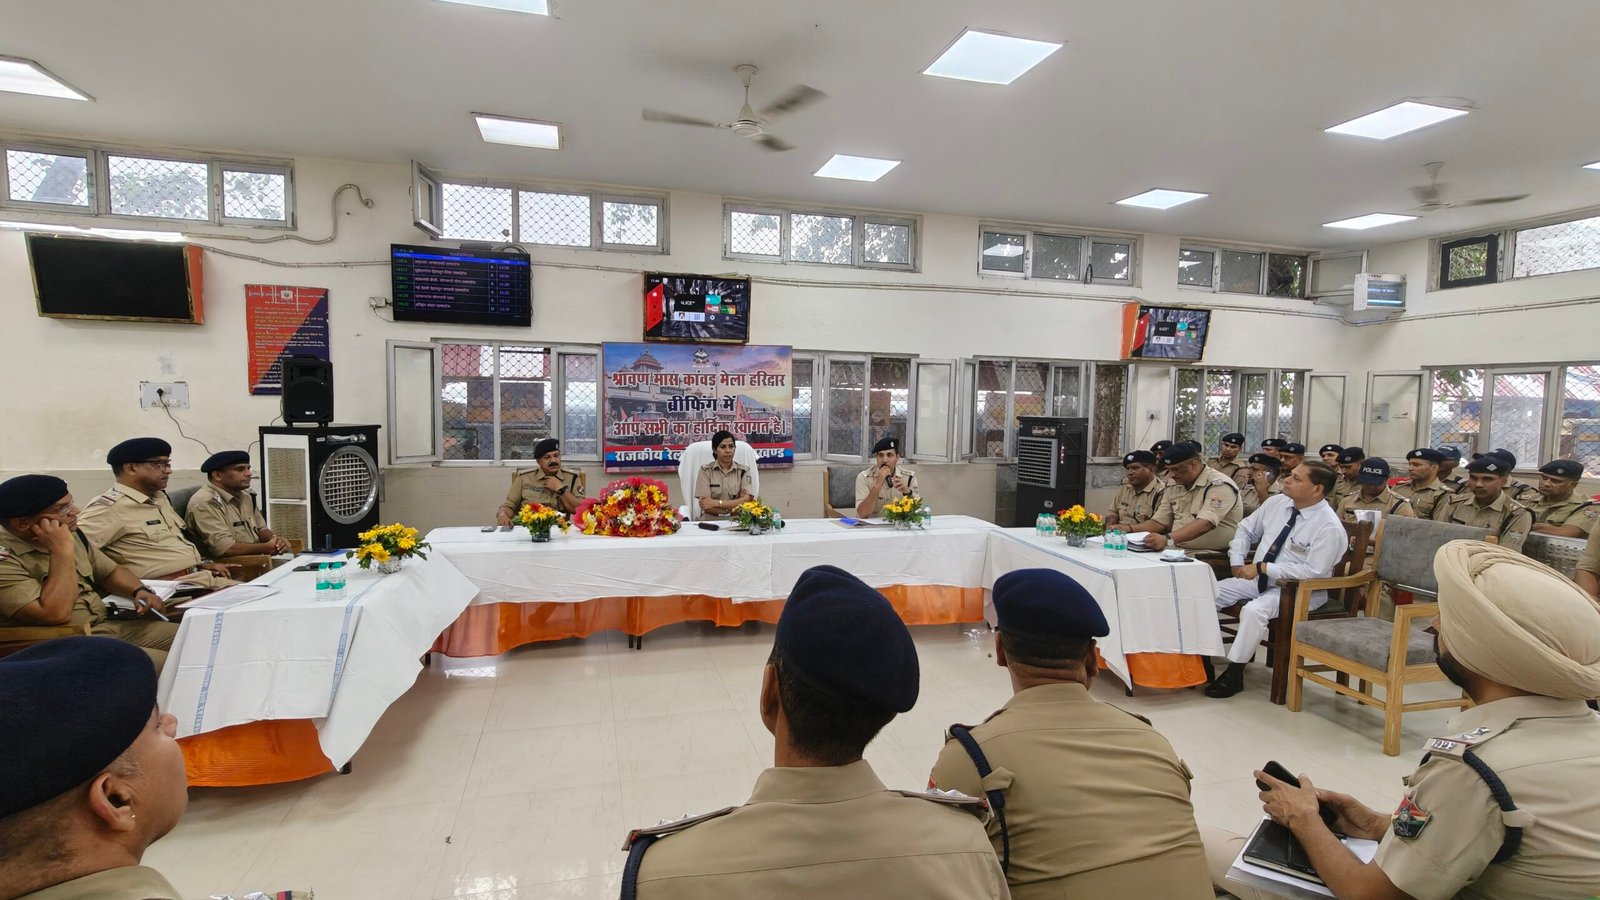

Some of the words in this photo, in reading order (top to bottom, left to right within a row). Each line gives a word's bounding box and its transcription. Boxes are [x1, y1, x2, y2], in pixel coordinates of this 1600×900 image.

[612, 372, 651, 387] श्रावण
[652, 372, 680, 387] मास
[719, 370, 746, 386] मेला
[748, 370, 786, 387] हरिद्वार
[666, 395, 718, 412] ब्रीफिंग
[722, 395, 737, 411] में
[613, 422, 641, 436] आप
[643, 418, 669, 436] सभी
[671, 422, 690, 435] का
[692, 418, 731, 434] हार्दिक
[733, 421, 770, 434] स्वागत
[614, 447, 663, 461] राजकीय
[1362, 467, 1383, 475] POLICE
